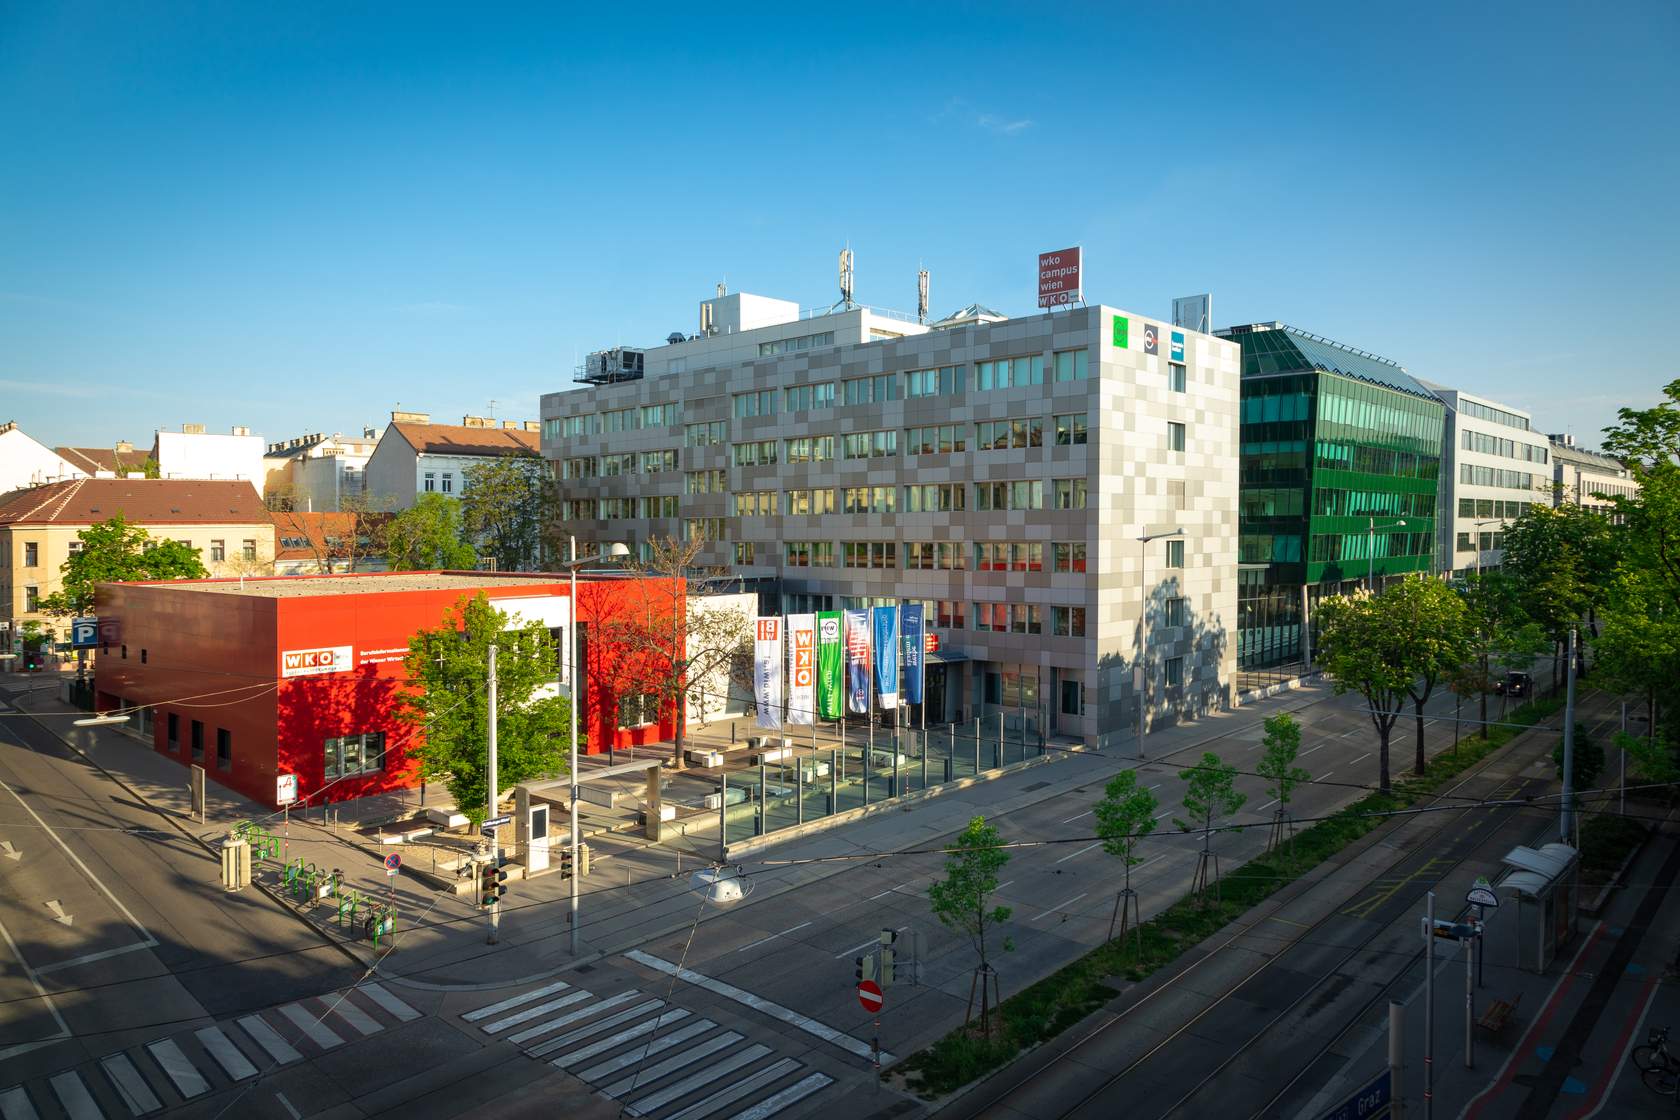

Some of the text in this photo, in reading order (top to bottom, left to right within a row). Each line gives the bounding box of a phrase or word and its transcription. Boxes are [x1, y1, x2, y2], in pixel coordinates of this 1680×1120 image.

[1041, 256, 1061, 267] wko
[1041, 265, 1078, 280] campus
[1041, 280, 1063, 291] wien
[1040, 293, 1068, 307] WKO
[78, 626, 94, 643] P
[286, 652, 332, 668] WKO
[1358, 1089, 1381, 1116] Graz
